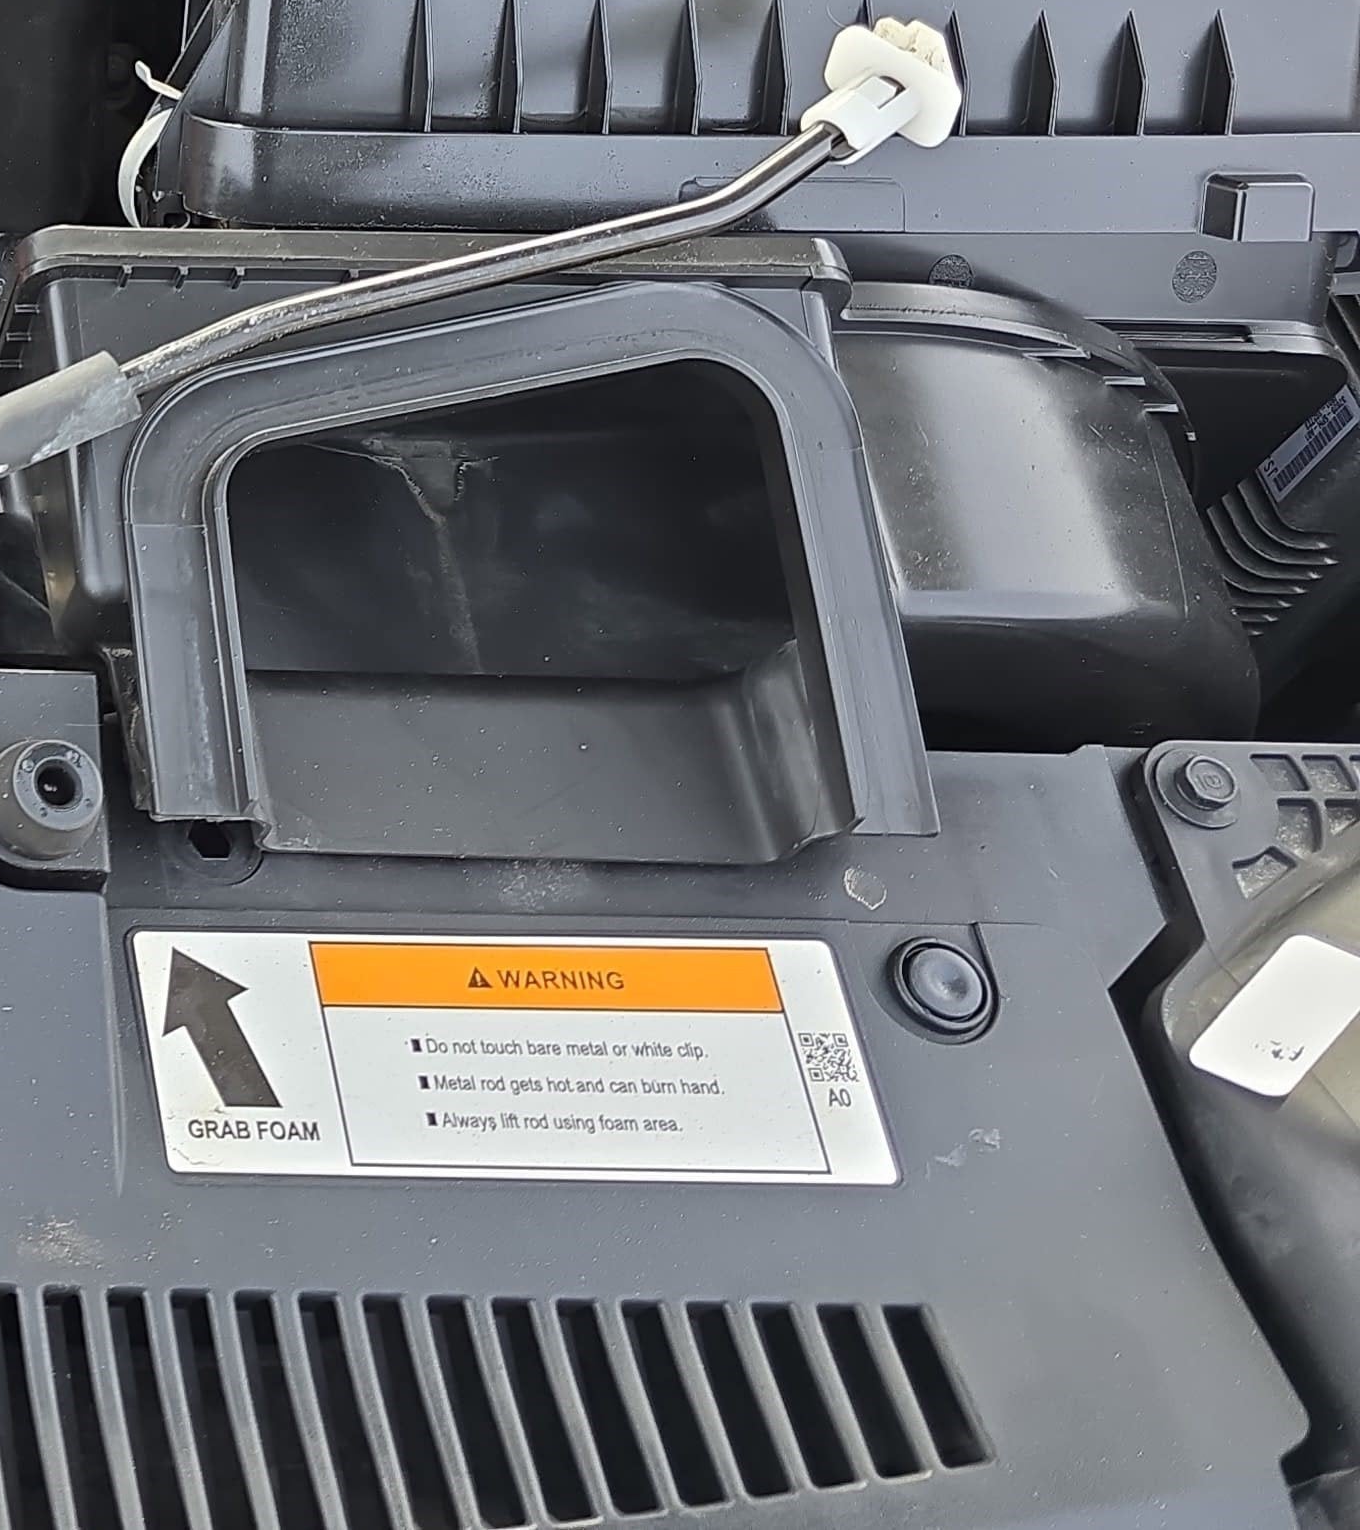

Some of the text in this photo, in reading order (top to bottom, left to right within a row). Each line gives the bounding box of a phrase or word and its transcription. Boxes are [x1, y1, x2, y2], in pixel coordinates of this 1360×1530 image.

[496, 970, 625, 990] WARNING
[425, 1038, 709, 1061] Do not touch bare metal or white clip.
[434, 1075, 725, 1096] Metal rod gets hot and can burn hand.
[187, 1119, 321, 1141] GRAB FOAM
[442, 1112, 683, 1133] Always lift rod using foam area.
